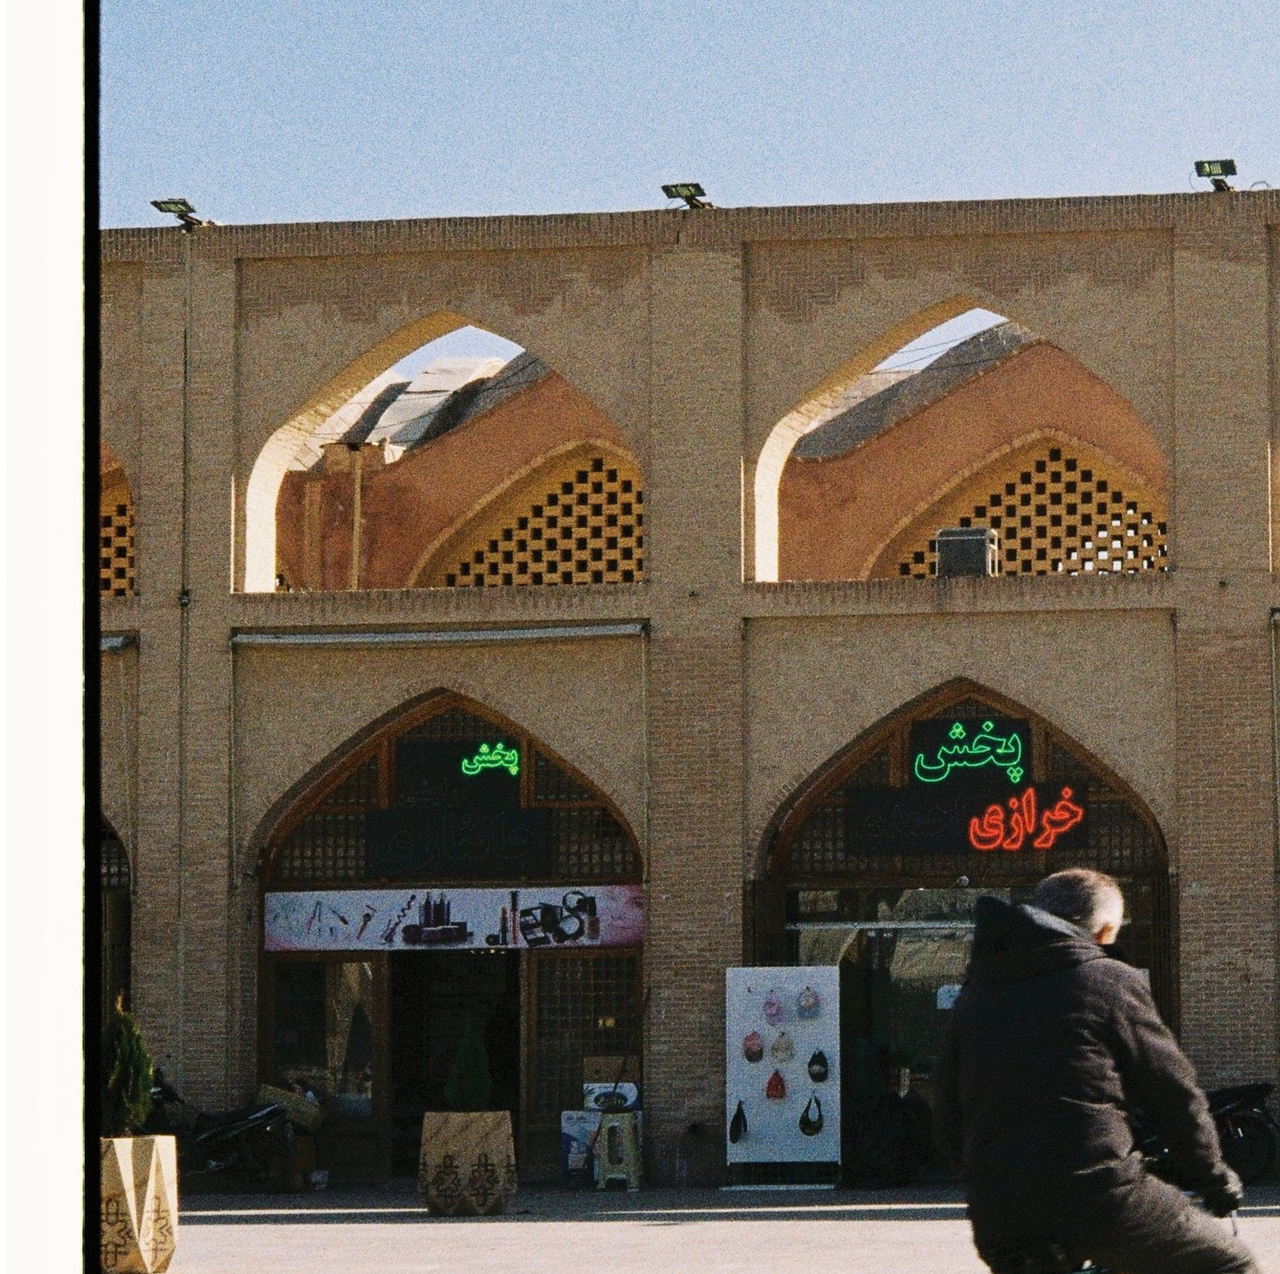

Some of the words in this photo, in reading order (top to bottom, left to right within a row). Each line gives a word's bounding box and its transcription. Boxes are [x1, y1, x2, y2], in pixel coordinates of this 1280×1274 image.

[462, 742, 520, 775] پخش
[914, 721, 1024, 783] پخش
[969, 787, 1082, 850] خرازی
